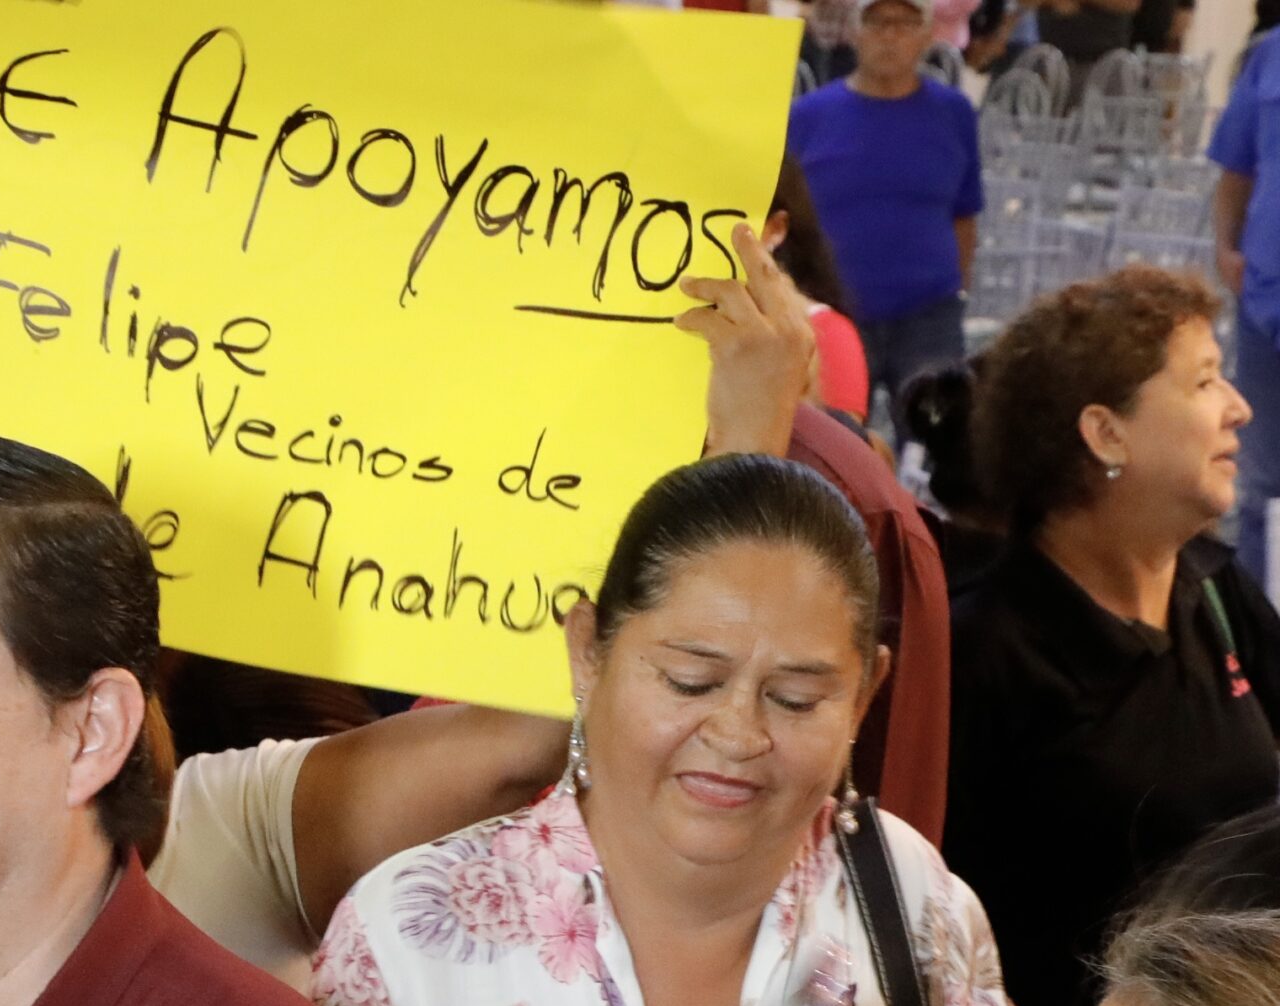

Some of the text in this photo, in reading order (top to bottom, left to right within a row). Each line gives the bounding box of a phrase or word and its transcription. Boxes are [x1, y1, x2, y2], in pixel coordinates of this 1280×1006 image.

[145, 26, 747, 308] Apoyamos
[196, 372, 582, 510] Vecinos de
[258, 491, 590, 632] Anahua
